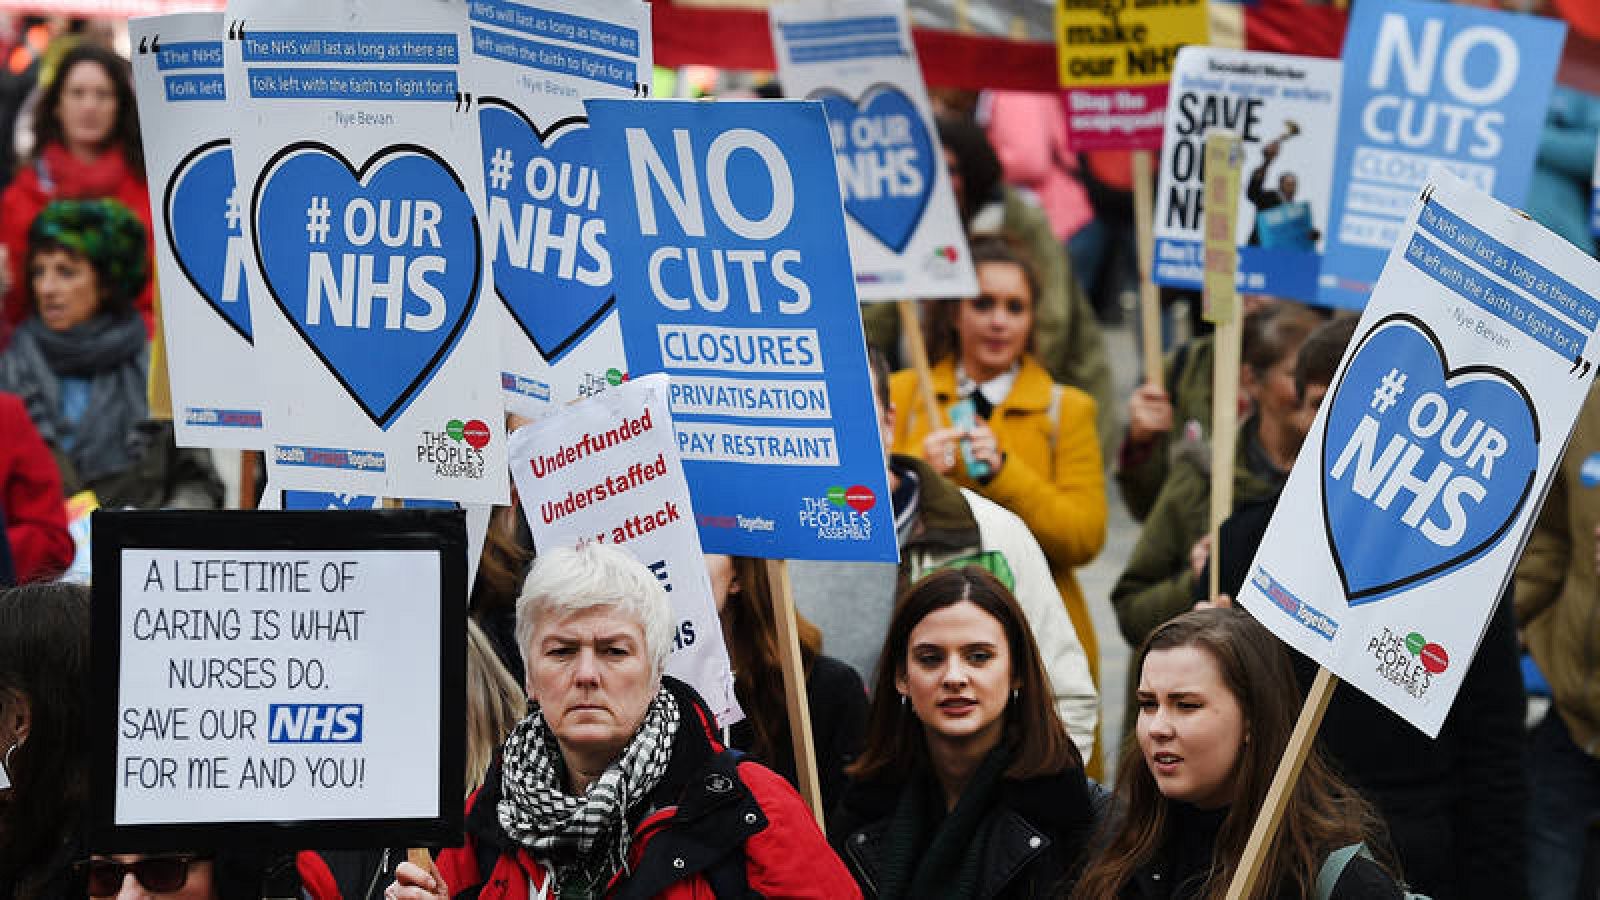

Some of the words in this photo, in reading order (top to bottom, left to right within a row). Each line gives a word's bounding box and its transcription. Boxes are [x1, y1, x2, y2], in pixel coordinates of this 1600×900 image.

[497, 8, 515, 23] will
[516, 11, 533, 28] last
[536, 17, 547, 31] as
[549, 17, 575, 39] long
[590, 28, 619, 46] there
[1068, 16, 1148, 45] make
[163, 48, 189, 64] The
[191, 47, 221, 64] NHS
[246, 40, 269, 55] The
[271, 40, 298, 55] NHS
[300, 40, 321, 55] will
[322, 40, 341, 56] last
[343, 46, 357, 56] as
[357, 40, 385, 60] long
[387, 45, 400, 56] as
[402, 41, 433, 57] there
[436, 45, 455, 57] are
[476, 34, 494, 52] left
[496, 41, 518, 58] with
[520, 46, 536, 62] the
[540, 49, 566, 67] faith
[582, 57, 606, 78] fight
[608, 63, 624, 81] for
[1069, 58, 1115, 77] our
[1368, 13, 1520, 105] NO
[169, 79, 197, 96] folk
[254, 74, 278, 91] folk
[279, 74, 300, 91] left
[302, 75, 329, 92] with
[330, 76, 348, 92] the
[349, 76, 377, 93] faith
[380, 79, 393, 93] to
[396, 77, 424, 96] fight
[425, 76, 442, 93] for
[335, 111, 355, 128] Nye
[357, 111, 394, 125] Bevan
[851, 115, 913, 148] OUR
[1176, 92, 1264, 143] SAVE
[1361, 96, 1505, 159] CUTS
[490, 147, 514, 190] #
[625, 127, 795, 241] NO
[836, 147, 924, 199] NHS
[305, 195, 331, 244] #
[344, 197, 443, 248] OUR
[485, 196, 613, 287] NHS
[649, 247, 811, 315] CUTS
[1437, 217, 1458, 239] NHS
[1457, 232, 1477, 251] will
[1476, 239, 1495, 261] last
[1494, 256, 1508, 271] as
[1510, 261, 1536, 289] long
[1536, 280, 1548, 295] as
[1549, 284, 1578, 312] there
[1577, 304, 1597, 323] are
[305, 251, 447, 332] NHS
[1440, 266, 1463, 284] with
[1464, 277, 1483, 298] the
[1484, 287, 1511, 313] faith
[1512, 305, 1525, 321] to
[1526, 312, 1552, 338] fight
[1553, 328, 1569, 348] for
[1454, 306, 1475, 329] Nye
[1475, 319, 1514, 352] Bevan
[664, 332, 814, 366] CLOSURES
[671, 383, 826, 411] PRIVATISATION
[422, 431, 448, 446] THE
[1371, 368, 1408, 413] #
[1408, 392, 1508, 480] OUR
[529, 406, 653, 478] Underfunded
[678, 432, 716, 453] PAY
[722, 432, 832, 459] RESTRAINT
[436, 463, 485, 479] ASSEMBLY
[541, 452, 667, 524] Understaffed
[1330, 414, 1488, 547] NHS
[802, 497, 829, 512] THE
[612, 501, 680, 545] attack
[818, 527, 871, 541] ASSEMBLY
[144, 560, 163, 592] A
[174, 560, 310, 592] LIFETIME
[320, 561, 358, 593] OF
[134, 608, 241, 641] CARING
[250, 609, 280, 641] IS
[292, 609, 365, 641] WHAT
[1383, 626, 1404, 652] THE
[169, 658, 277, 690] NURSES
[288, 658, 329, 689] DO.
[1376, 663, 1425, 699] ASSEMBLY
[123, 708, 190, 741] SAVE
[200, 708, 257, 741] OUR
[269, 706, 360, 741] NHS
[124, 756, 177, 789] FOR
[188, 757, 230, 789] ME
[240, 756, 295, 789] AND
[306, 757, 366, 789] YOU!
